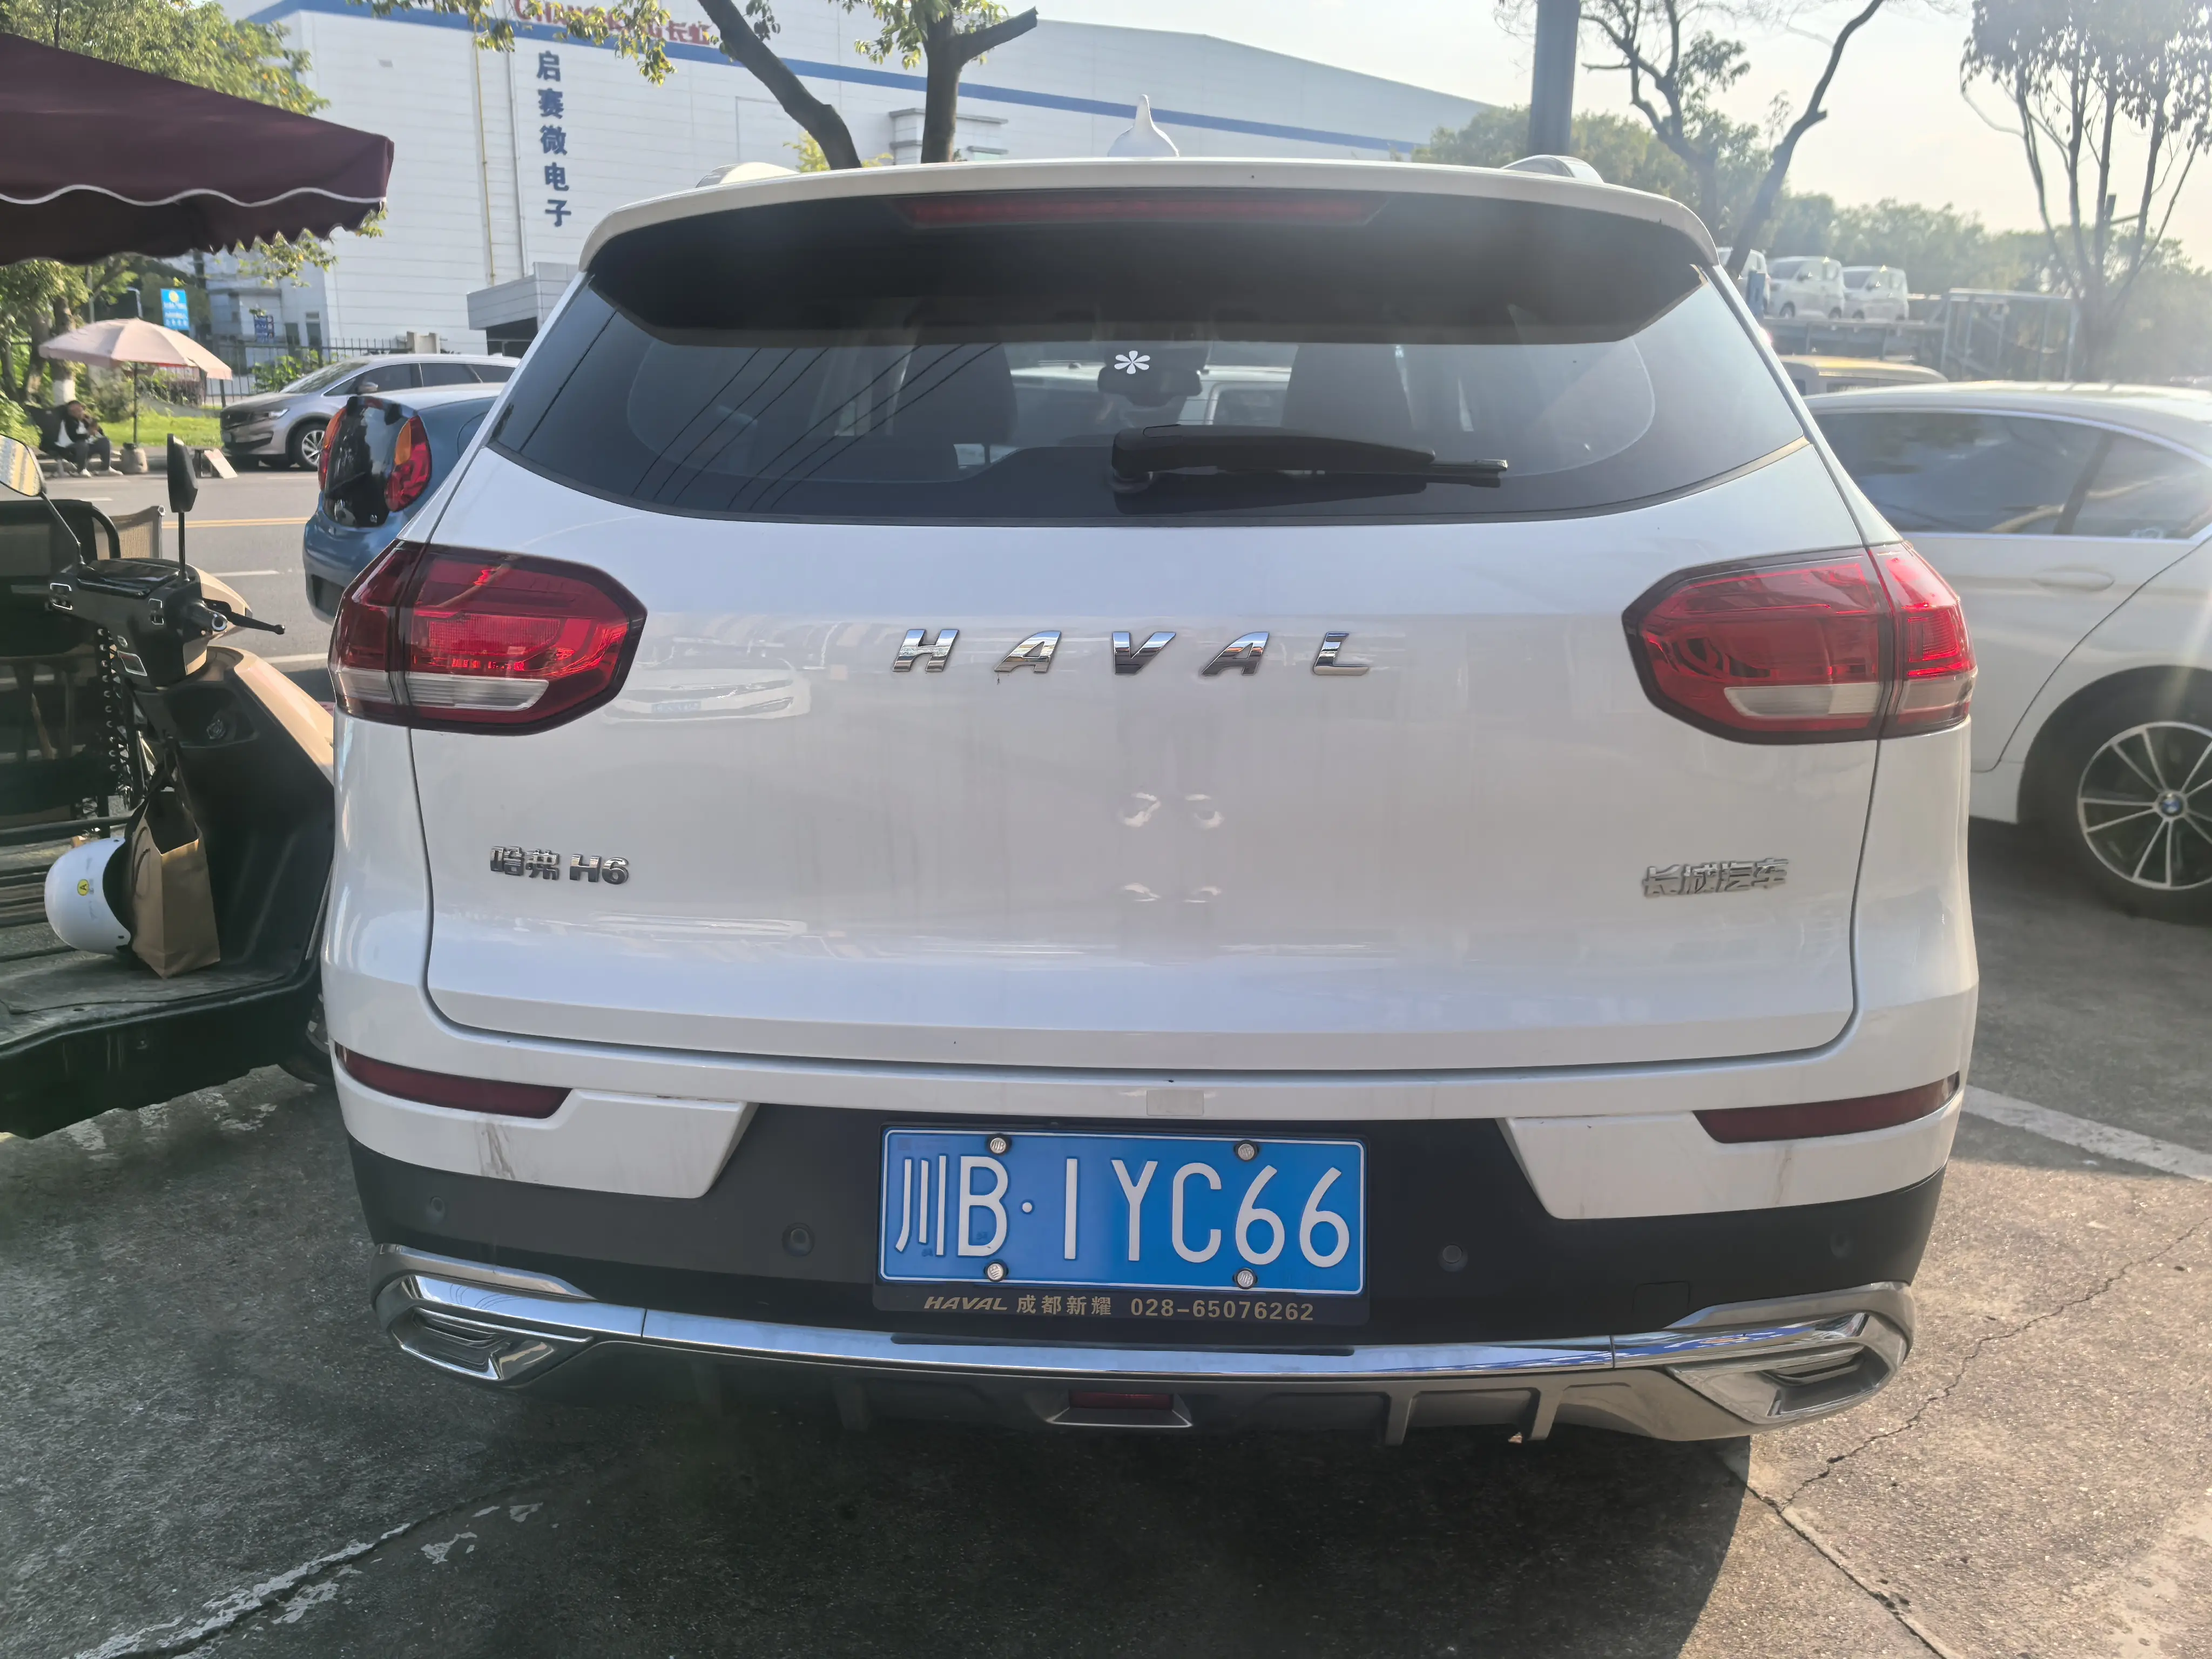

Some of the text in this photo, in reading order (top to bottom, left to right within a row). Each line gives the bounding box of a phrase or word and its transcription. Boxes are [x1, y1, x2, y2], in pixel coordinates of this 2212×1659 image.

[536, 50, 572, 227] 启赛微电子
[892, 629, 1370, 676] HAVAL
[490, 846, 629, 885] 哈弗 H6
[1642, 858, 1789, 898] 长城汽车
[924, 1294, 1313, 1321] HAVAL 成都新耀 028-65076262
